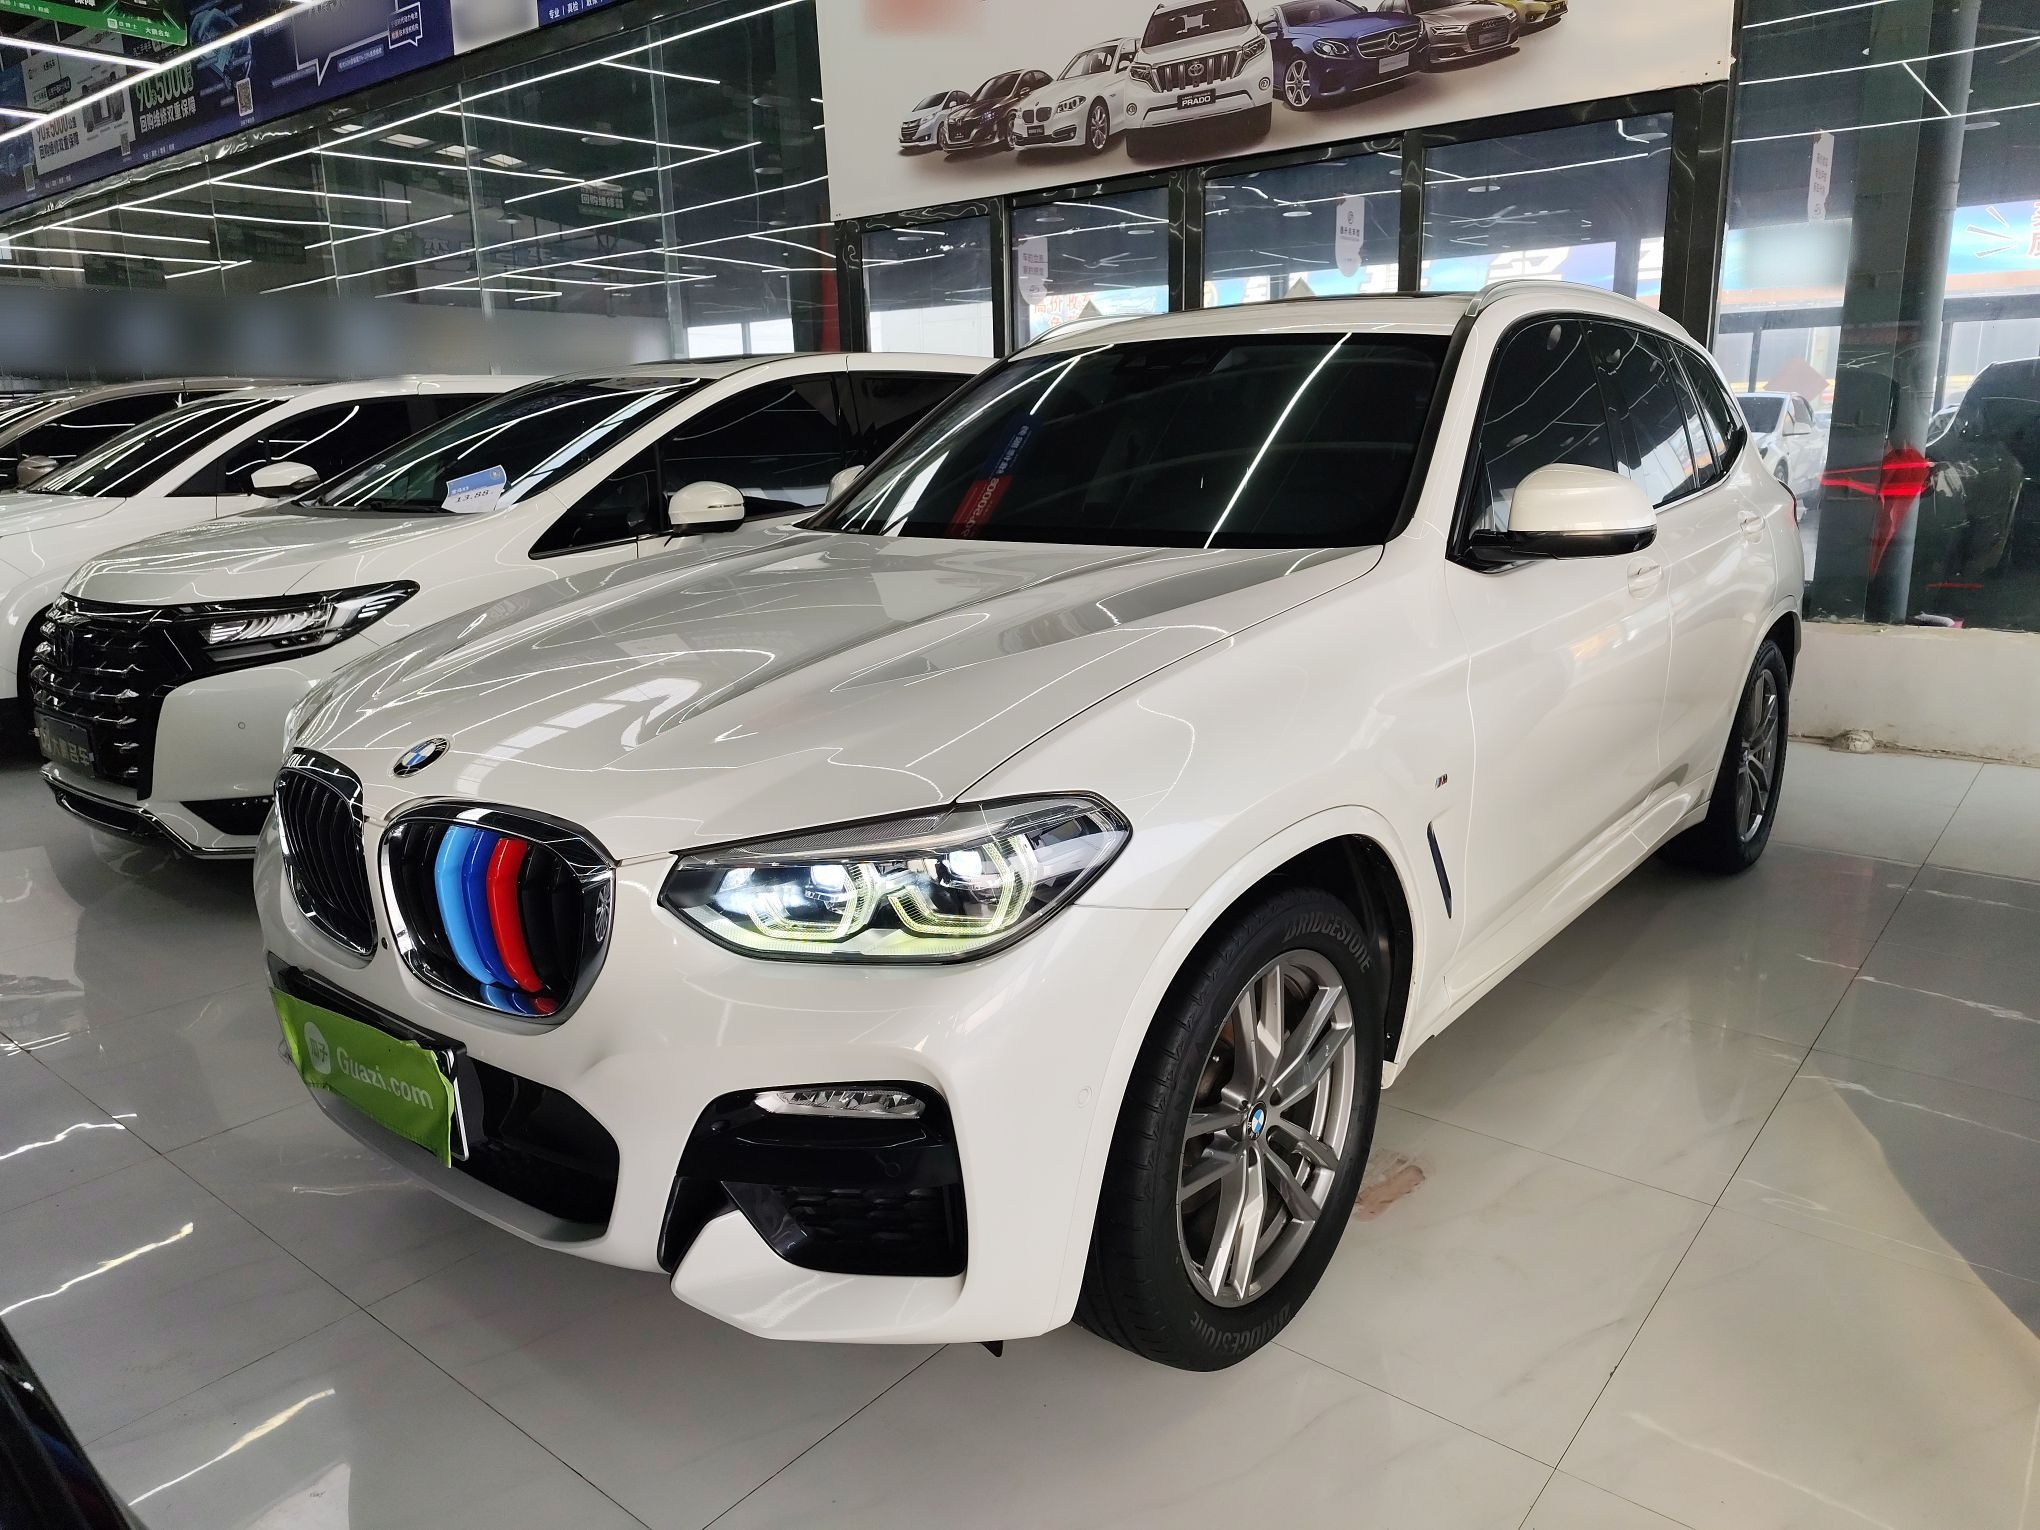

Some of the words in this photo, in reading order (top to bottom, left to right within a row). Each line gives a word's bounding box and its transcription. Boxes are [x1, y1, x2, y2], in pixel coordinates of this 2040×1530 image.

[140, 96, 196, 133] 回购维修双重保障
[1181, 96, 1211, 107] PRADO
[1281, 911, 1371, 974] BRIDGESTONE
[336, 1047, 434, 1111] Guazi.com
